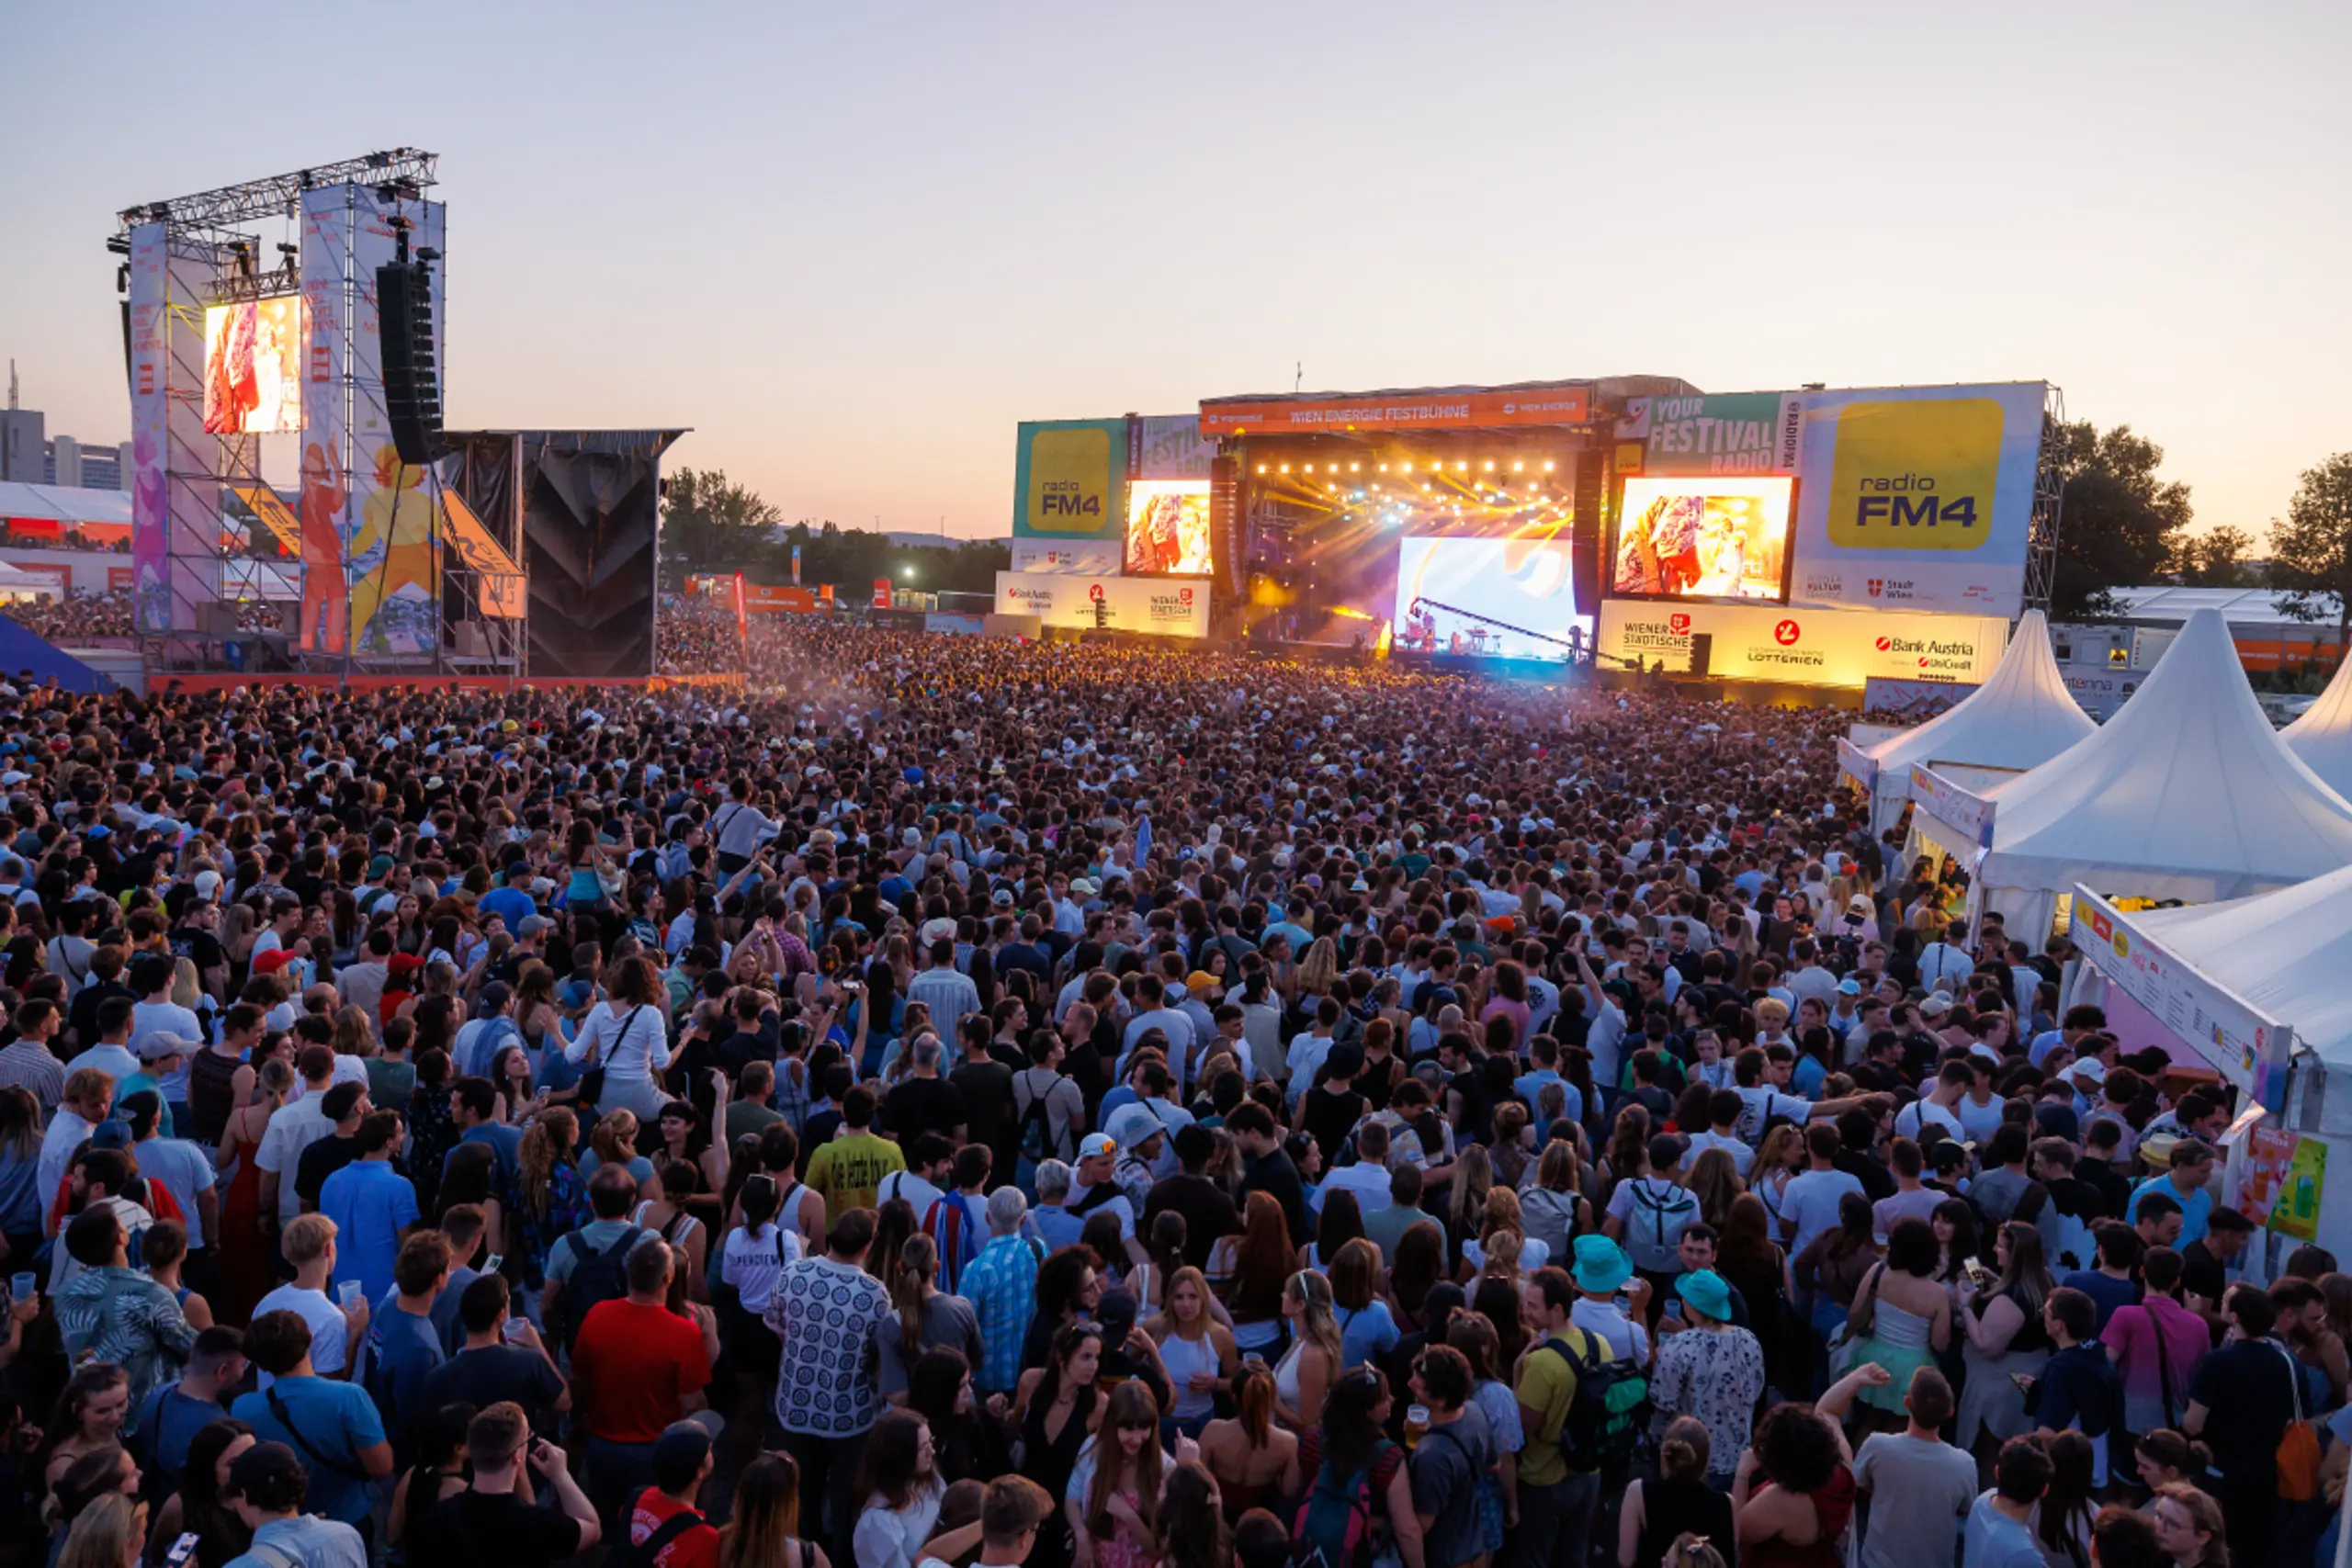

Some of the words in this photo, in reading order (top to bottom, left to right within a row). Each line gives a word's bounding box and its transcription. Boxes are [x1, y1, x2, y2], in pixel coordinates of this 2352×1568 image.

[1291, 410, 1322, 423] WIEN
[1325, 408, 1383, 423] ENERGIE
[1385, 403, 1470, 421] FESTBÜHNE
[1657, 398, 1704, 422] YOUR
[1650, 417, 1772, 454] FESTIVAL
[1711, 449, 1771, 475] RADIO
[1043, 479, 1080, 491] radio
[1860, 473, 1936, 491] radio
[1042, 494, 1101, 516] FM4
[1856, 496, 1977, 527] FM4
[1623, 622, 1669, 635] WIENER
[1623, 633, 1690, 648] STÄDTISCHE
[1891, 637, 1926, 654] Bank
[1927, 640, 1973, 656] Austria
[1747, 653, 1825, 666] LOTTERIEN
[1928, 658, 1972, 671] UniCredit
[2063, 676, 2112, 691] ntenna
